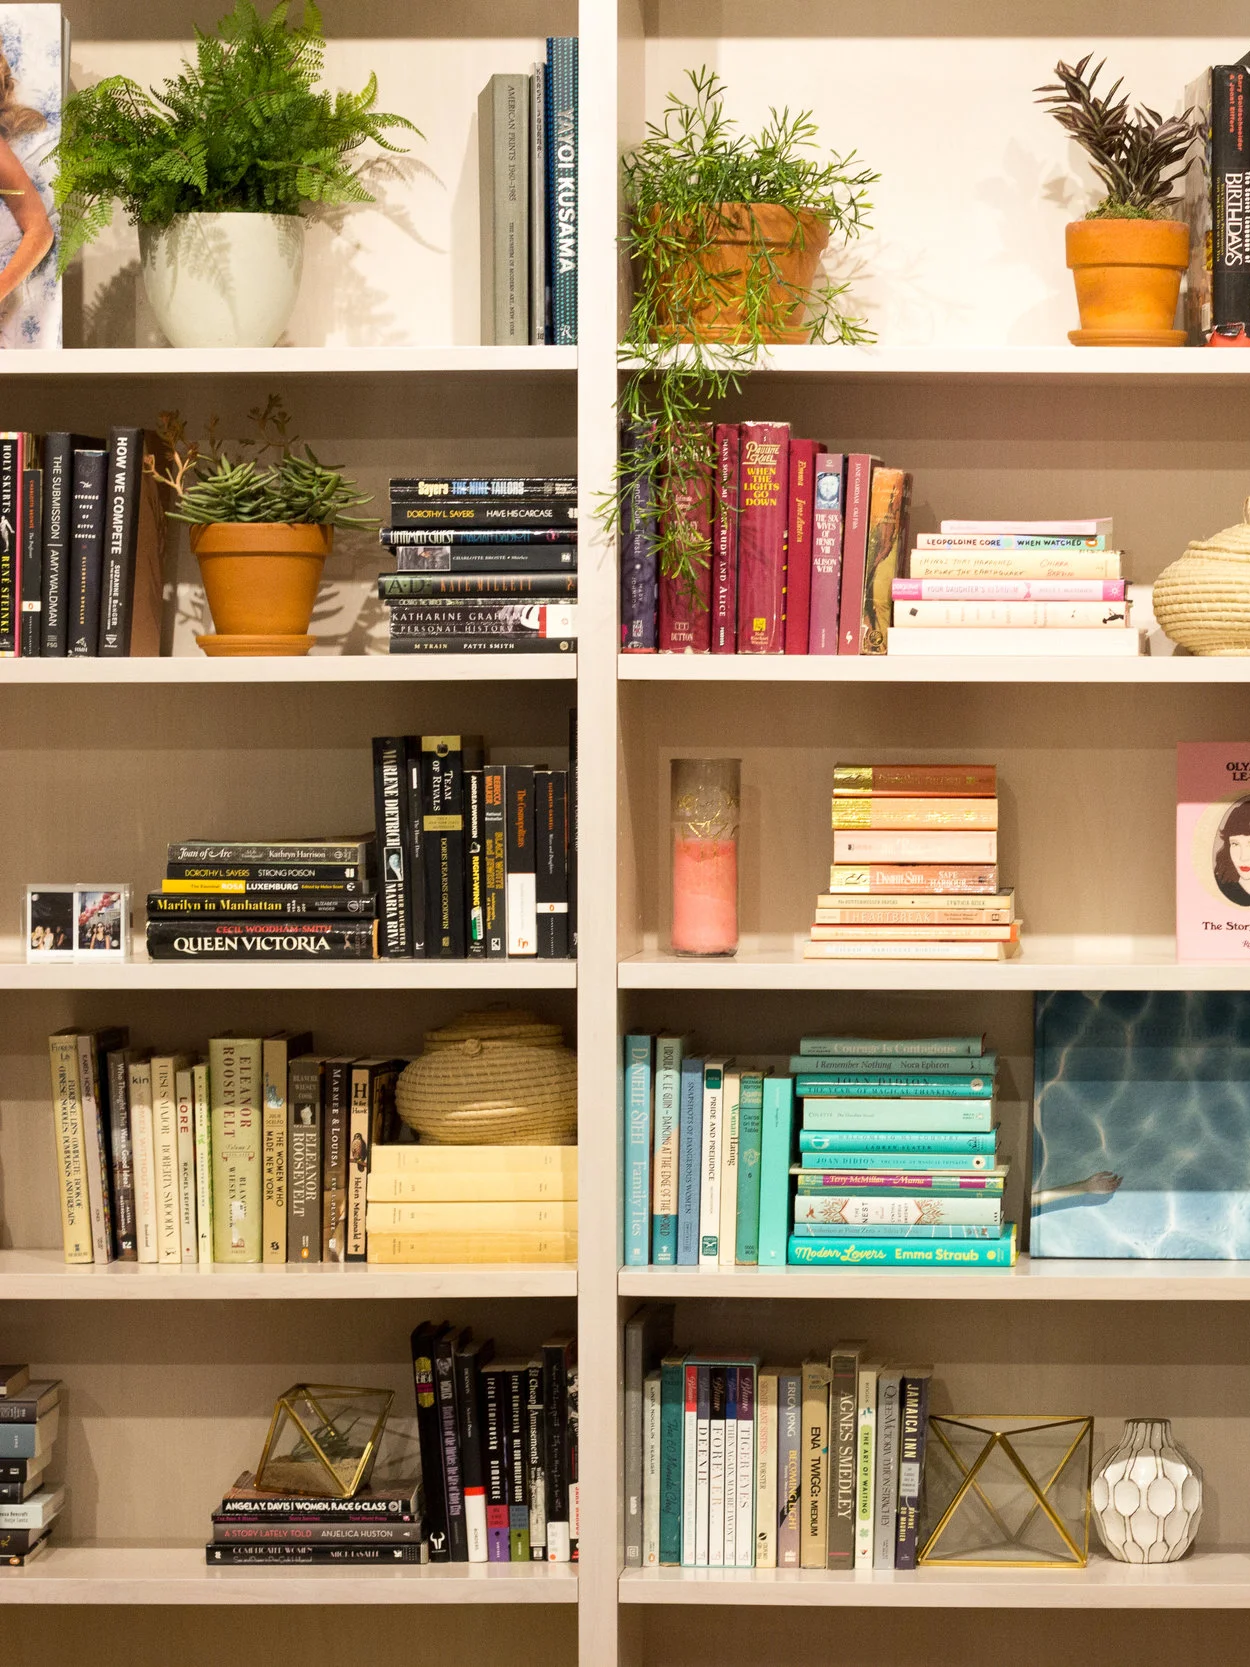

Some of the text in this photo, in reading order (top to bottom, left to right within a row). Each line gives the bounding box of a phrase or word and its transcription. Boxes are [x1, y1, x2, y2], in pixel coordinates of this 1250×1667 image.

[557, 108, 576, 274] YAYOI KUSAMA
[1225, 173, 1243, 266] BIRTHDAYS
[111, 437, 128, 555] HOW WE COMPETE
[744, 483, 780, 491] LIGHTS
[746, 467, 777, 475] WHEN
[746, 498, 777, 506] DOWN
[1, 444, 13, 634] HOLY SKIRTS RENÉ STEINKE
[48, 455, 63, 627] THE SUBMISSION AMY WALDMAN
[382, 750, 401, 847] MARLENE DIETRICH
[432, 761, 442, 811] OF RIVALS
[444, 771, 453, 800] TEAM
[157, 900, 283, 913] Marilyn in Manhattan
[246, 883, 298, 891] LUXEMBURG
[385, 884, 399, 947] MARIA RIVA
[1202, 922, 1223, 931] The
[174, 937, 331, 954] QUEEN VICTORIA
[709, 1097, 717, 1119] PRIDE
[293, 1132, 305, 1217] ROOSEVELT
[305, 1132, 317, 1200] ELEANOR
[708, 1140, 716, 1181] PREJUDICE
[895, 1248, 979, 1261] Emma Straub
[904, 1384, 919, 1458] JAMAICA INN
[838, 1391, 854, 1519] AGNES SMEDLEY
[810, 1427, 821, 1536] ENA TWIGG: MEDIUM
[322, 1530, 393, 1538] ANJELICA HUSTON
